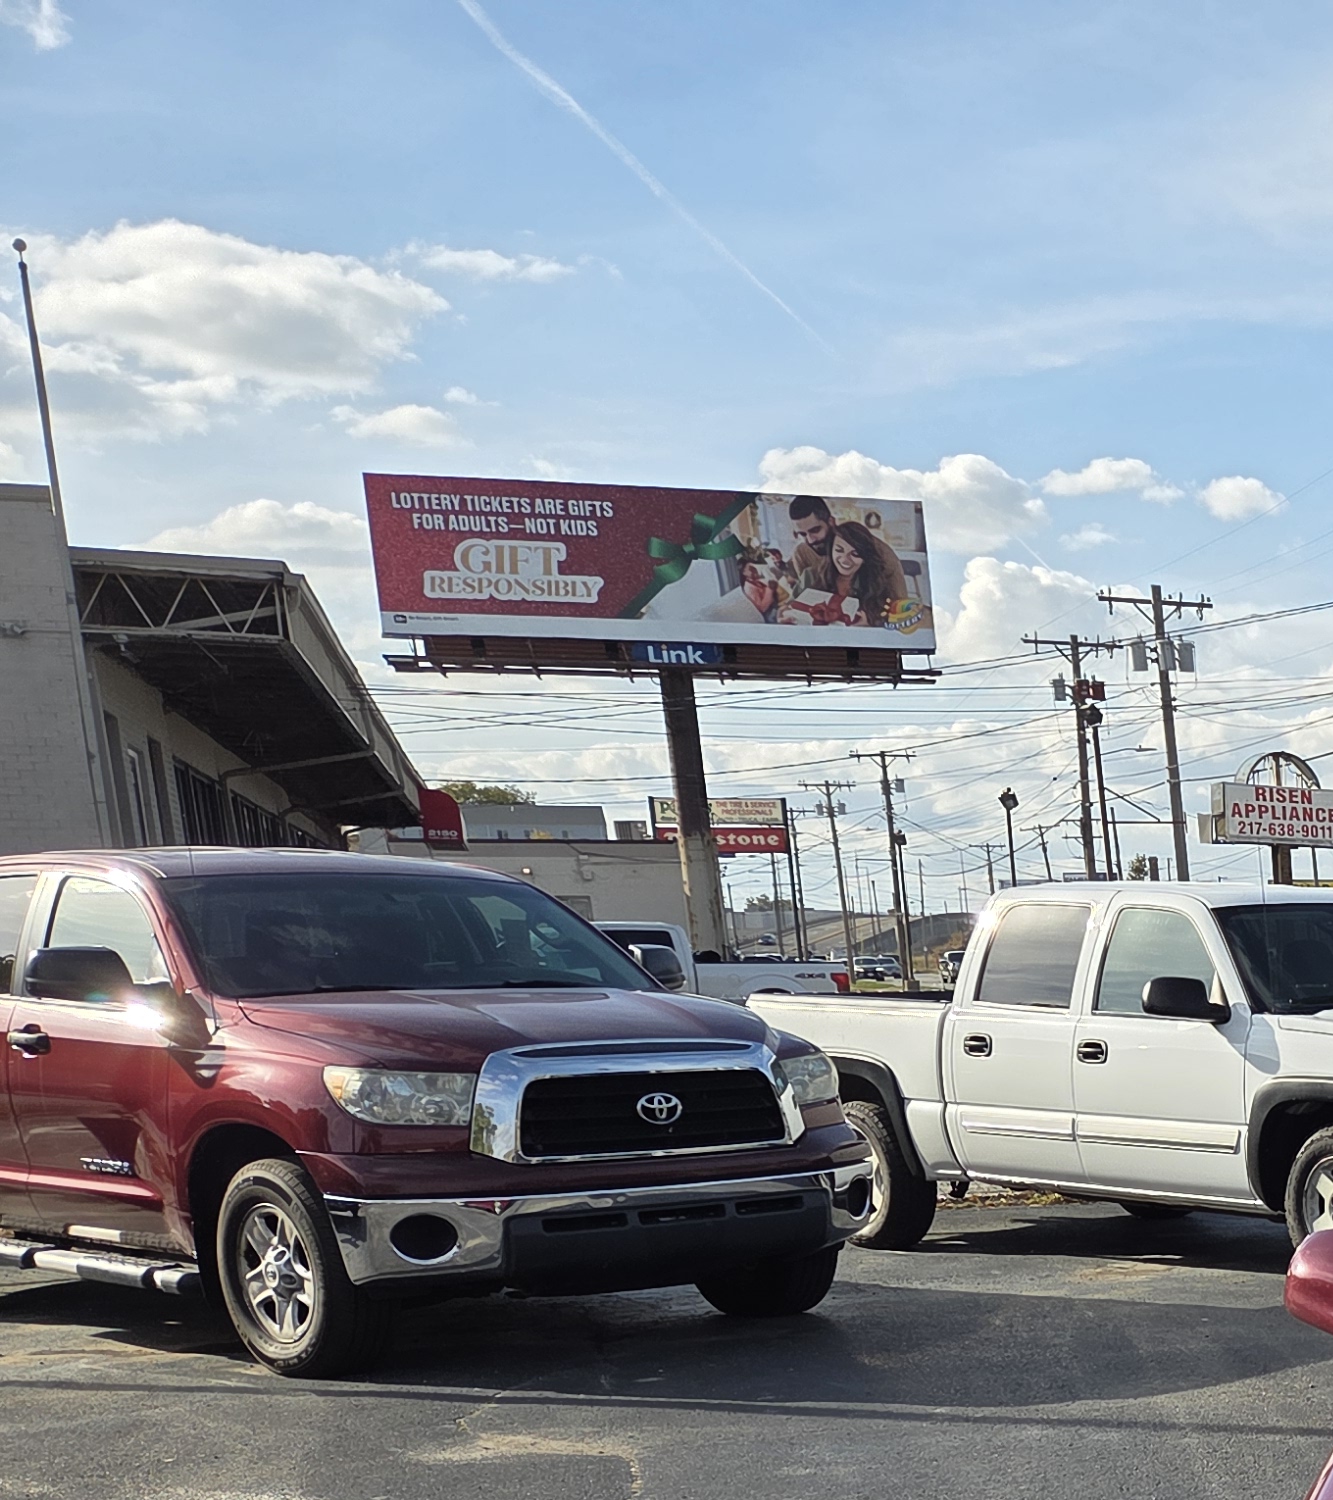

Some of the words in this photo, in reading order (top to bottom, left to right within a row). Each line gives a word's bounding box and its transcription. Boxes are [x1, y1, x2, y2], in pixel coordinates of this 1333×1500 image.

[391, 492, 461, 510] LOTTERY
[464, 495, 531, 513] TICKETS
[535, 498, 564, 515] ARE
[568, 500, 613, 517] GIFTS
[413, 513, 445, 530] FOR
[560, 520, 598, 536] KIDS
[460, 543, 561, 576] GIFT
[430, 576, 598, 598] RESPONSIBLY
[647, 644, 705, 664] Link
[1255, 786, 1313, 804] RISEN
[1238, 821, 1332, 838] 217-638-9011
